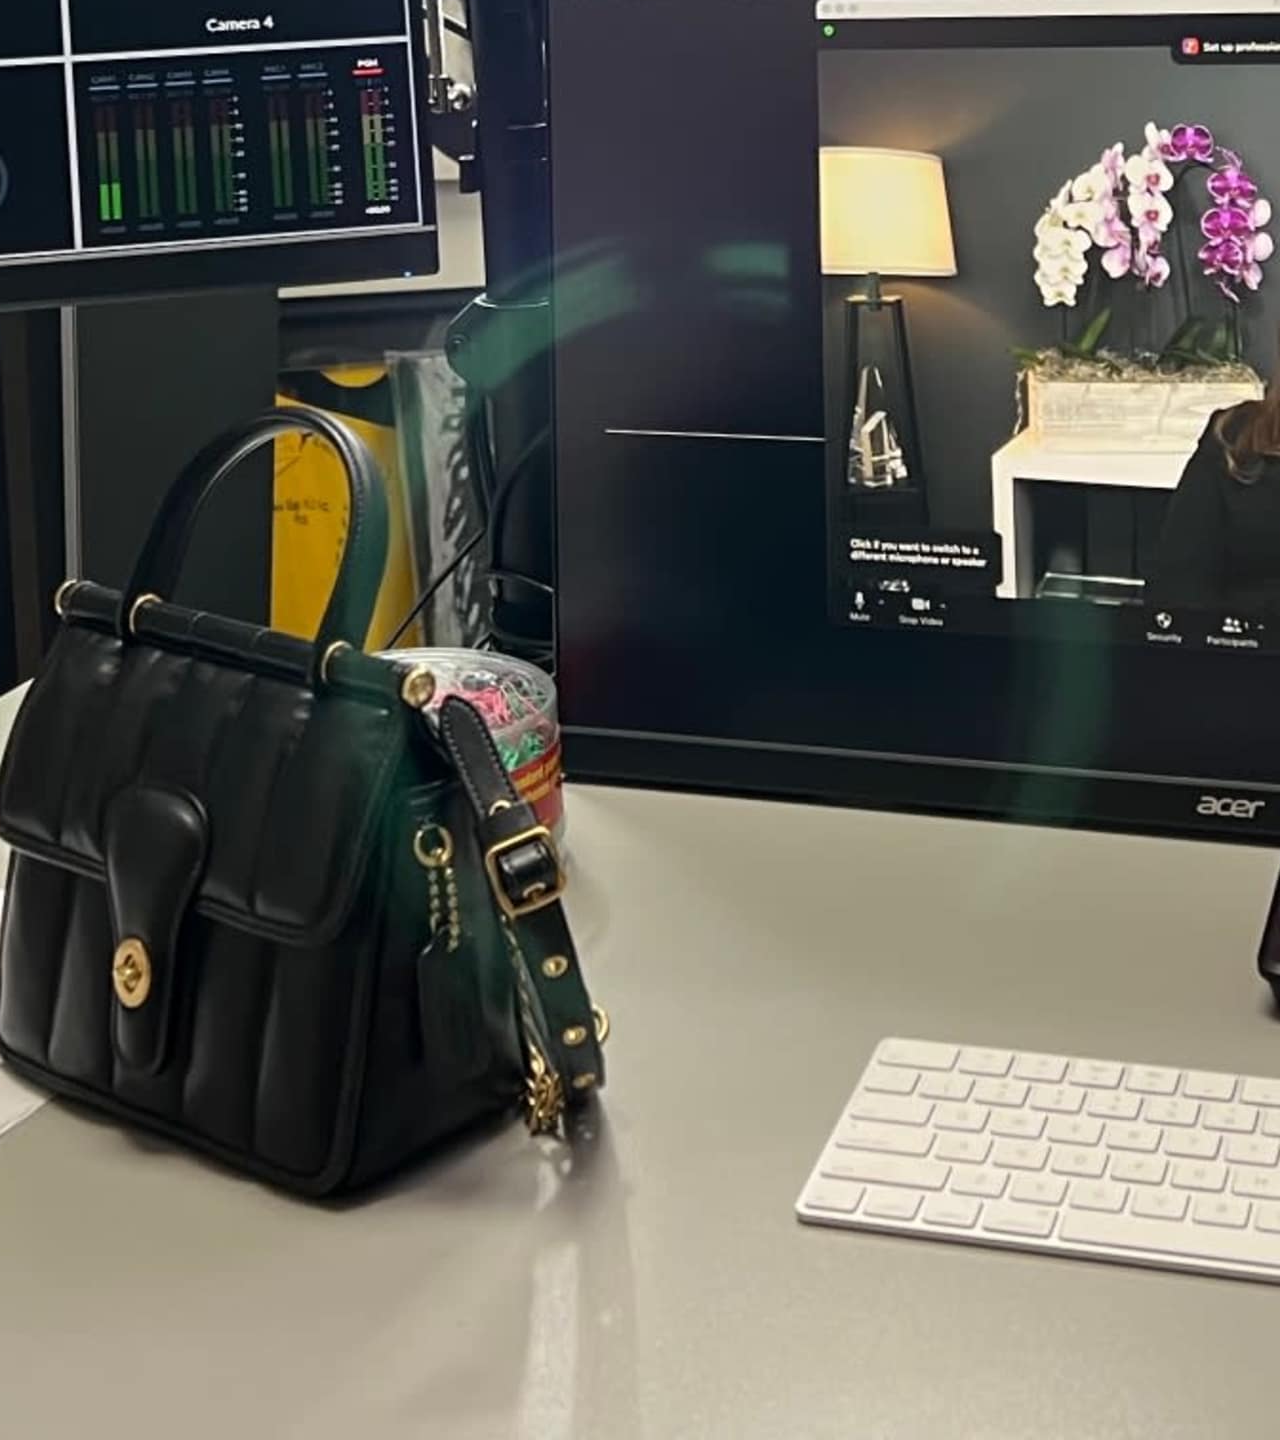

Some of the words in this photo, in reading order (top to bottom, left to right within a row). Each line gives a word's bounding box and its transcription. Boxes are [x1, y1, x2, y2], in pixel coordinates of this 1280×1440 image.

[205, 17, 261, 33] Camera
[263, 15, 274, 30] 4
[1194, 793, 1266, 820] acer
